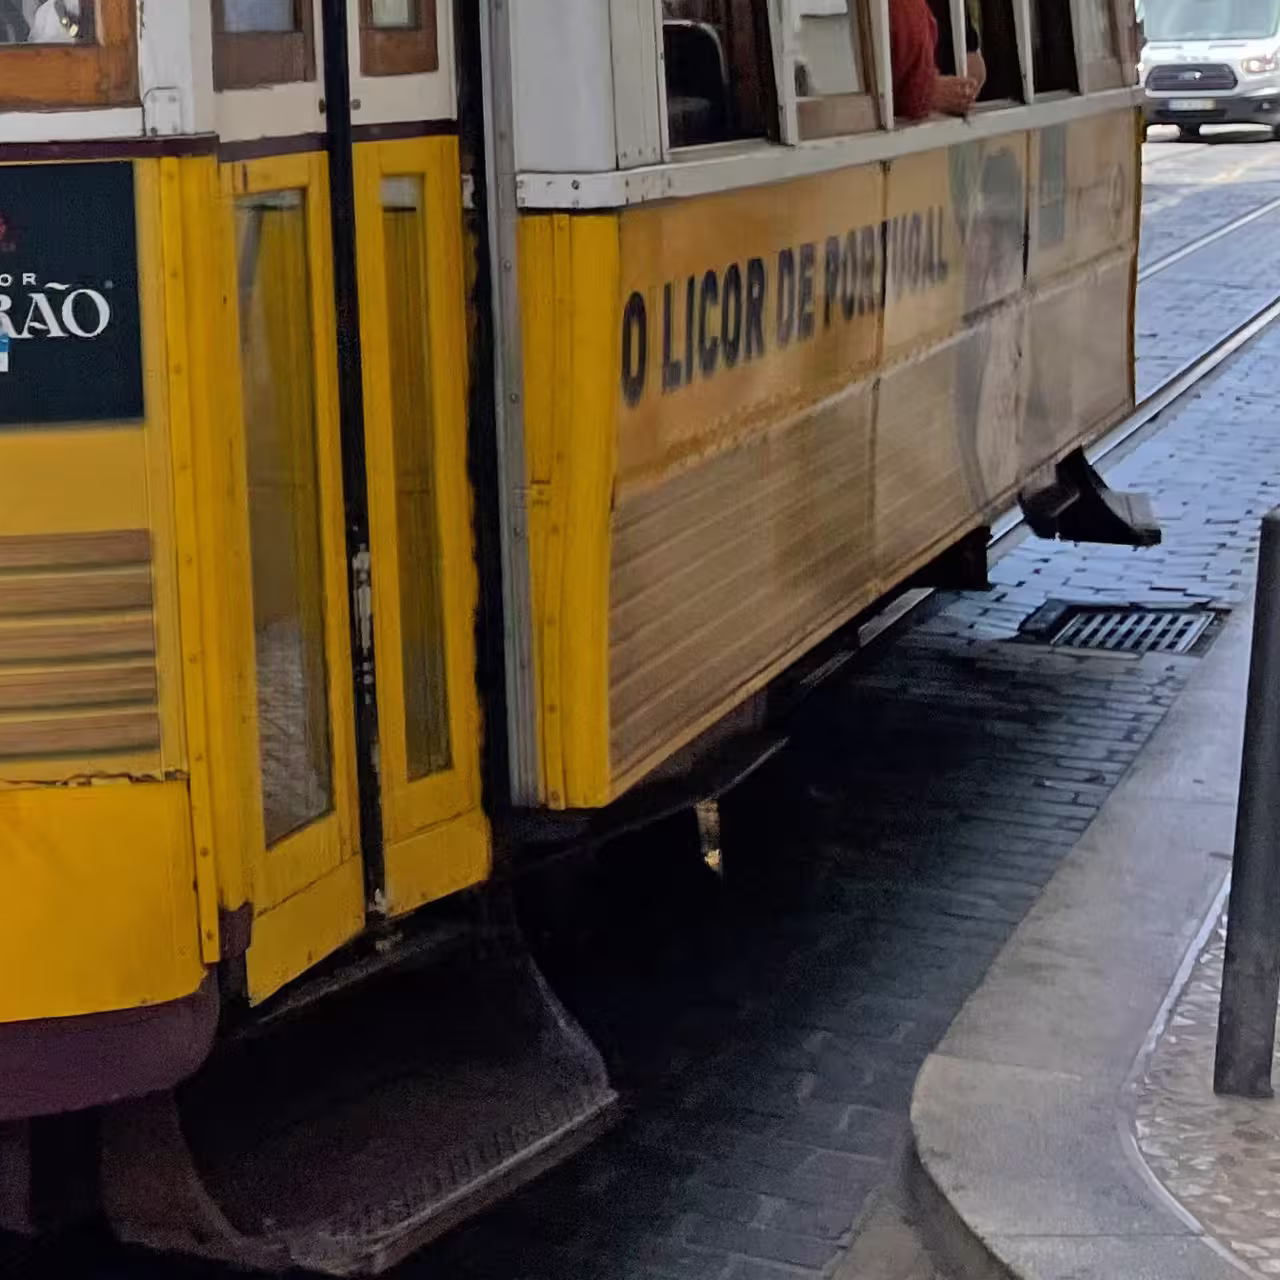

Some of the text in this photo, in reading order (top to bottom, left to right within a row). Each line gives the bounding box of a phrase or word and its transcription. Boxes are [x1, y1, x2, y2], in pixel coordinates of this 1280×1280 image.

[621, 290, 647, 409] O
[662, 256, 766, 396] LICOR
[776, 242, 817, 350] DE
